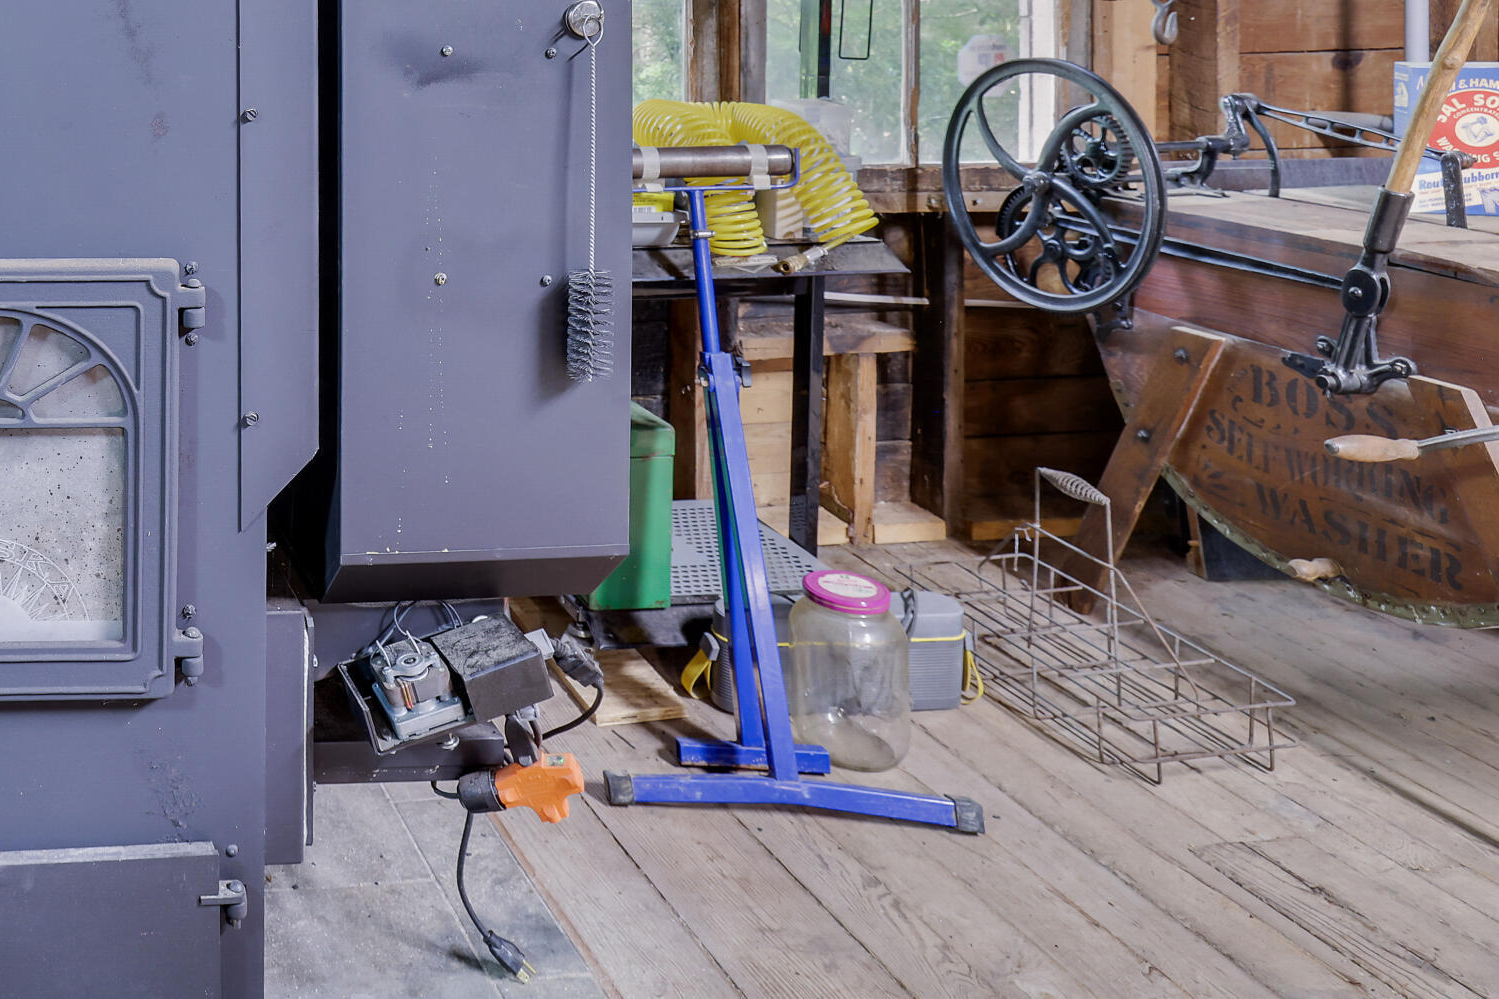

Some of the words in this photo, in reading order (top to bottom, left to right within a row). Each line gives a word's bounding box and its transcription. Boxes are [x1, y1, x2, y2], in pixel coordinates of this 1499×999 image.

[1473, 93, 1499, 109] SO
[1250, 363, 1403, 441] BOSS
[1252, 480, 1465, 592] WASHER
